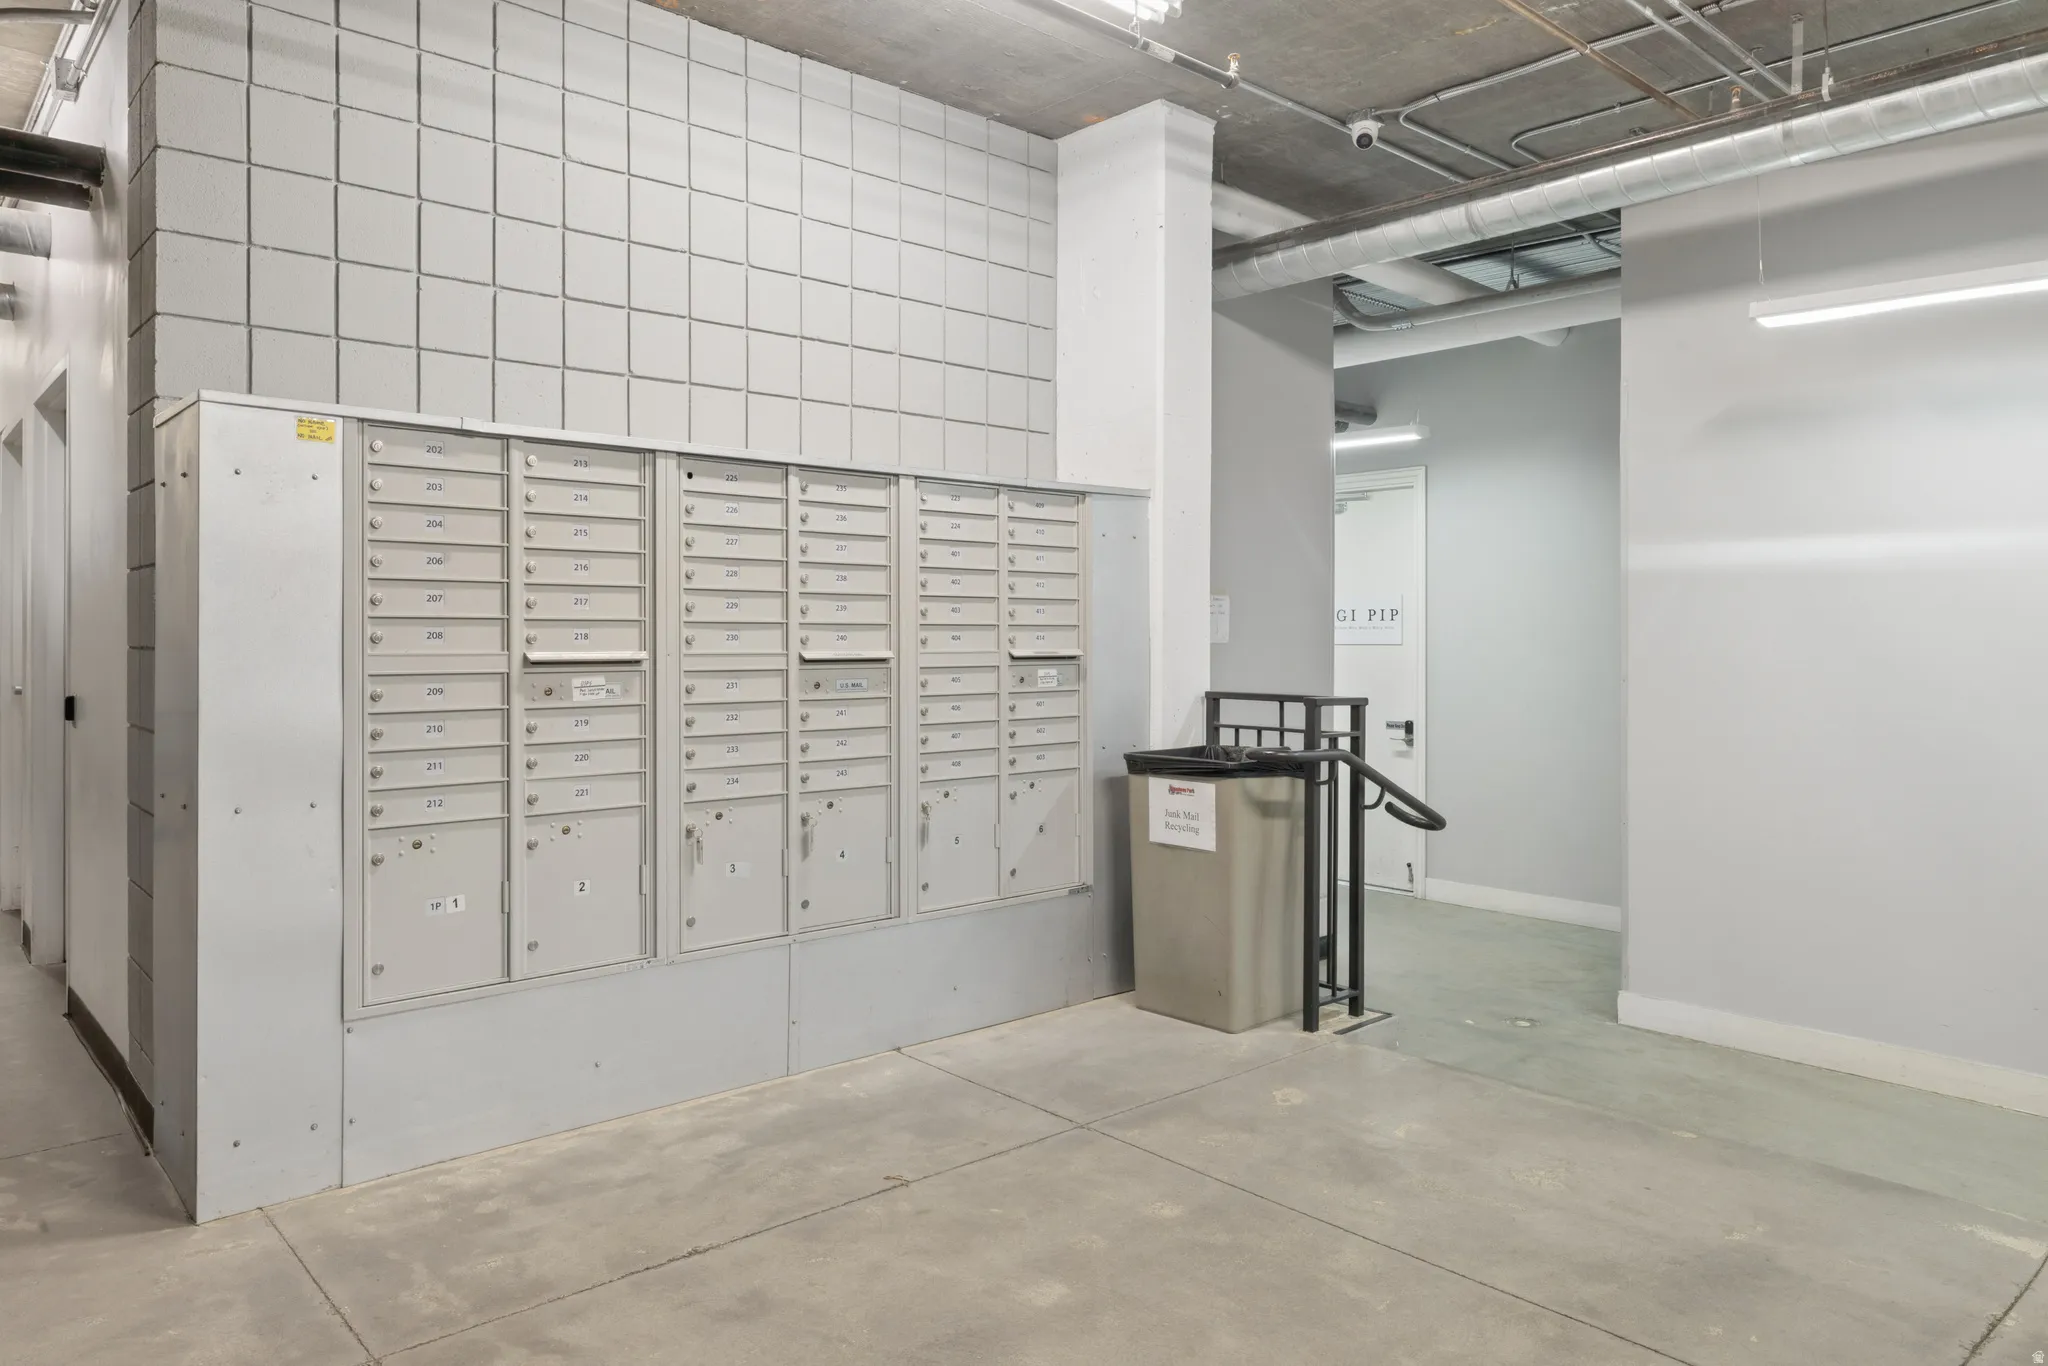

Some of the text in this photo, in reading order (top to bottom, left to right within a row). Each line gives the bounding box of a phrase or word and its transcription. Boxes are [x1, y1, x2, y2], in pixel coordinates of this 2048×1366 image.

[427, 445, 442, 454] 202
[725, 474, 738, 482] 225
[427, 483, 442, 491] 203
[836, 484, 847, 492] 235
[726, 506, 738, 514] 226
[726, 538, 738, 546] 227
[836, 544, 847, 552] 237
[427, 557, 443, 565] 206
[1368, 608, 1399, 622] PIP
[575, 719, 588, 727] 219
[427, 725, 442, 733] 210
[427, 762, 441, 770] 211
[726, 777, 739, 785] 234
[427, 799, 442, 808] 212
[1165, 809, 1200, 821] Junk Mail
[1039, 825, 1043, 833] 6
[1165, 821, 1200, 836] Recycling
[955, 837, 959, 845] 5
[839, 850, 845, 859] 4
[730, 864, 735, 873] 3
[579, 882, 585, 892] 2
[431, 902, 441, 910] 1P
[453, 898, 458, 908] 1
